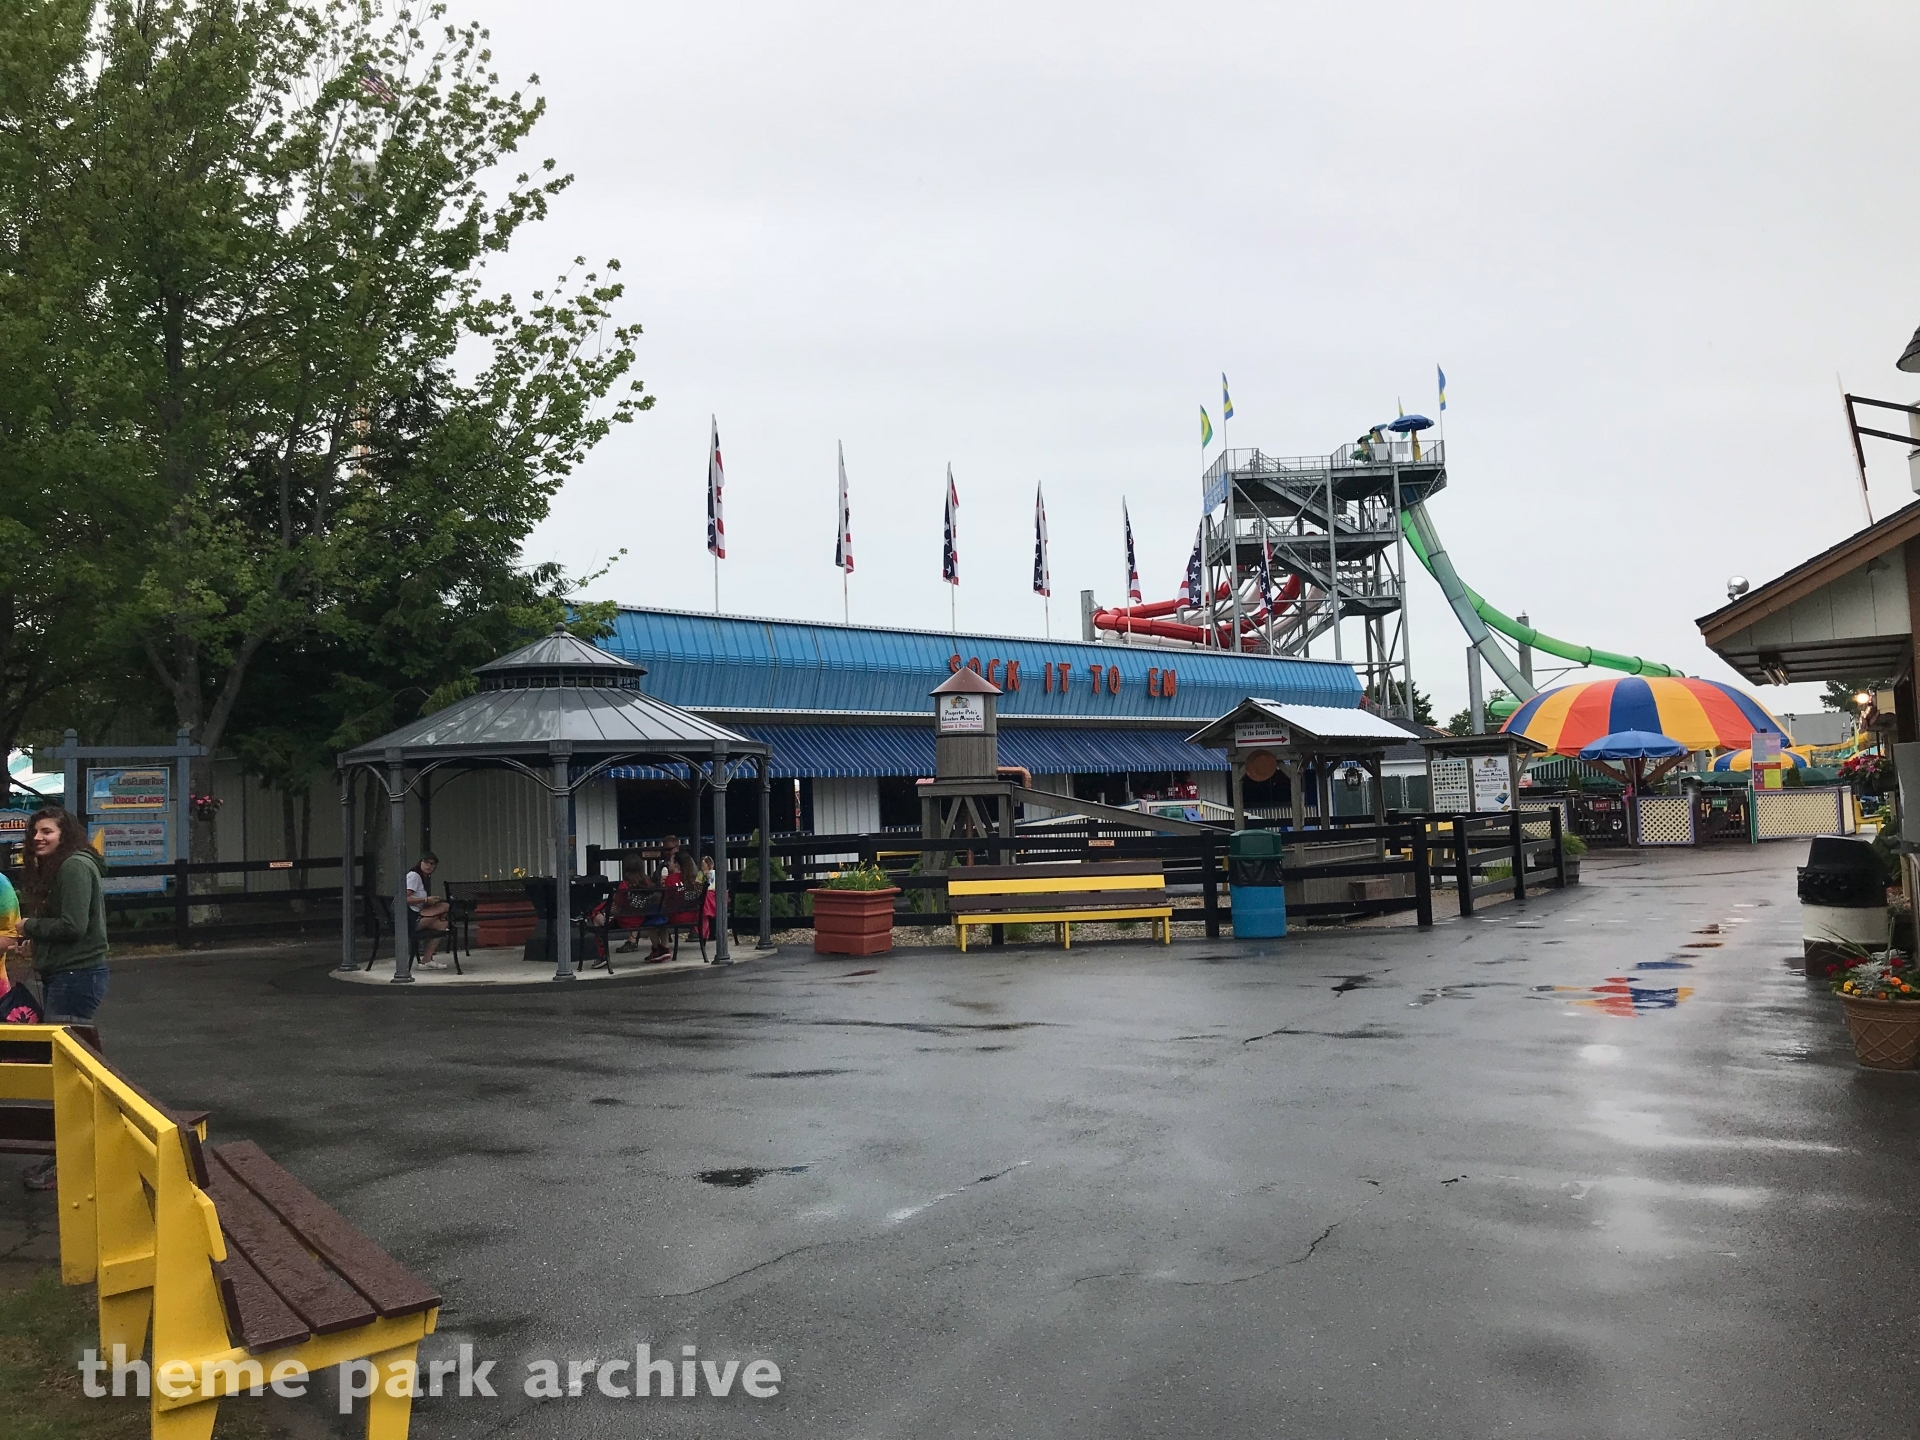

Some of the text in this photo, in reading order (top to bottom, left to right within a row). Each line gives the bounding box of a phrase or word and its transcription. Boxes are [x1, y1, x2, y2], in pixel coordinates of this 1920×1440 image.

[950, 654, 1177, 697] SOCK IT TO EM
[138, 795, 165, 804] CANOES
